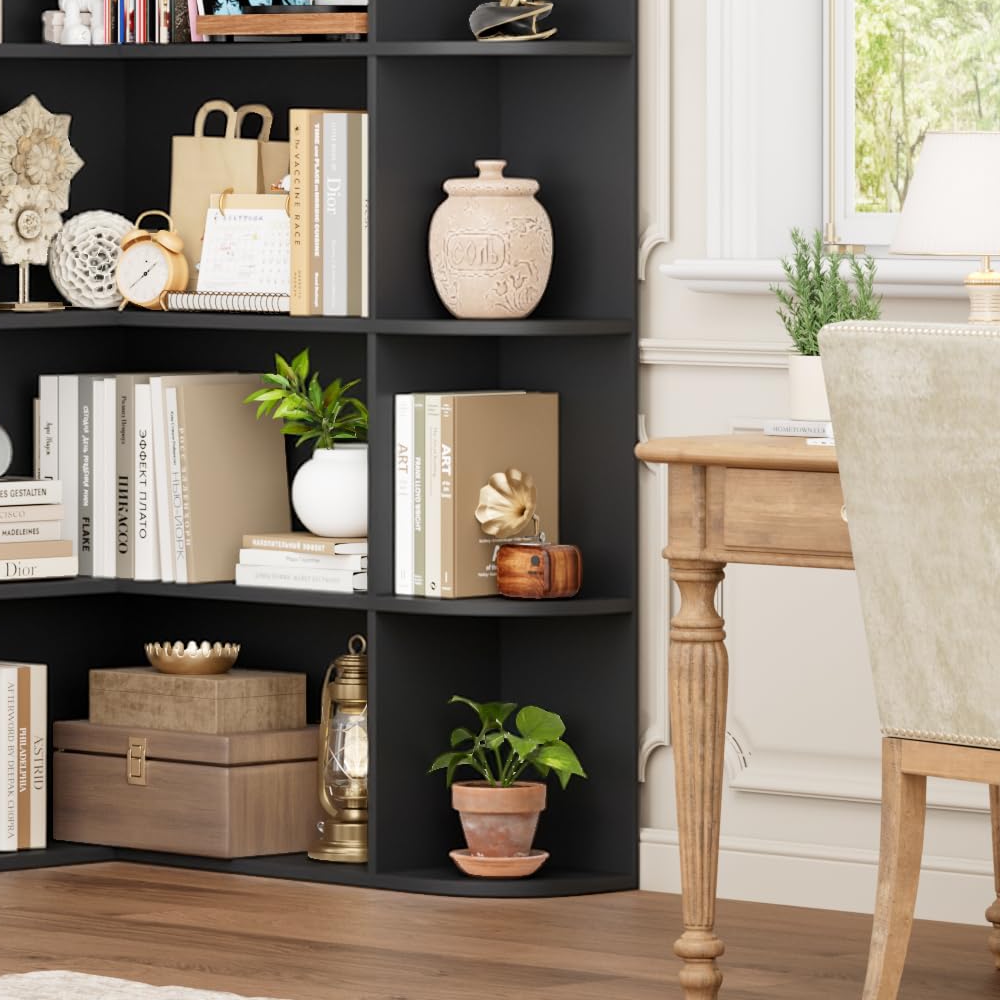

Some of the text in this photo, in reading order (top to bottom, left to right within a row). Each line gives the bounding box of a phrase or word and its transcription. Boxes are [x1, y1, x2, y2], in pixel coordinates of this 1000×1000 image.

[326, 176, 342, 216] Dior
[397, 443, 408, 474] ART
[441, 444, 451, 476] ART
[10, 488, 47, 498] GESTALTEN
[138, 429, 148, 539] ЭФФЕКТ ПЛАТО
[1, 527, 40, 537] MADELEINES
[117, 475, 129, 554] ПИКАССО
[82, 517, 91, 552] FLAKE
[5, 561, 38, 578] Dior
[7, 681, 16, 840] AFTERWORD BY DEEPAK CHOPRA
[19, 727, 27, 793] PHILADELPHIA
[33, 735, 46, 791] ASTRID
